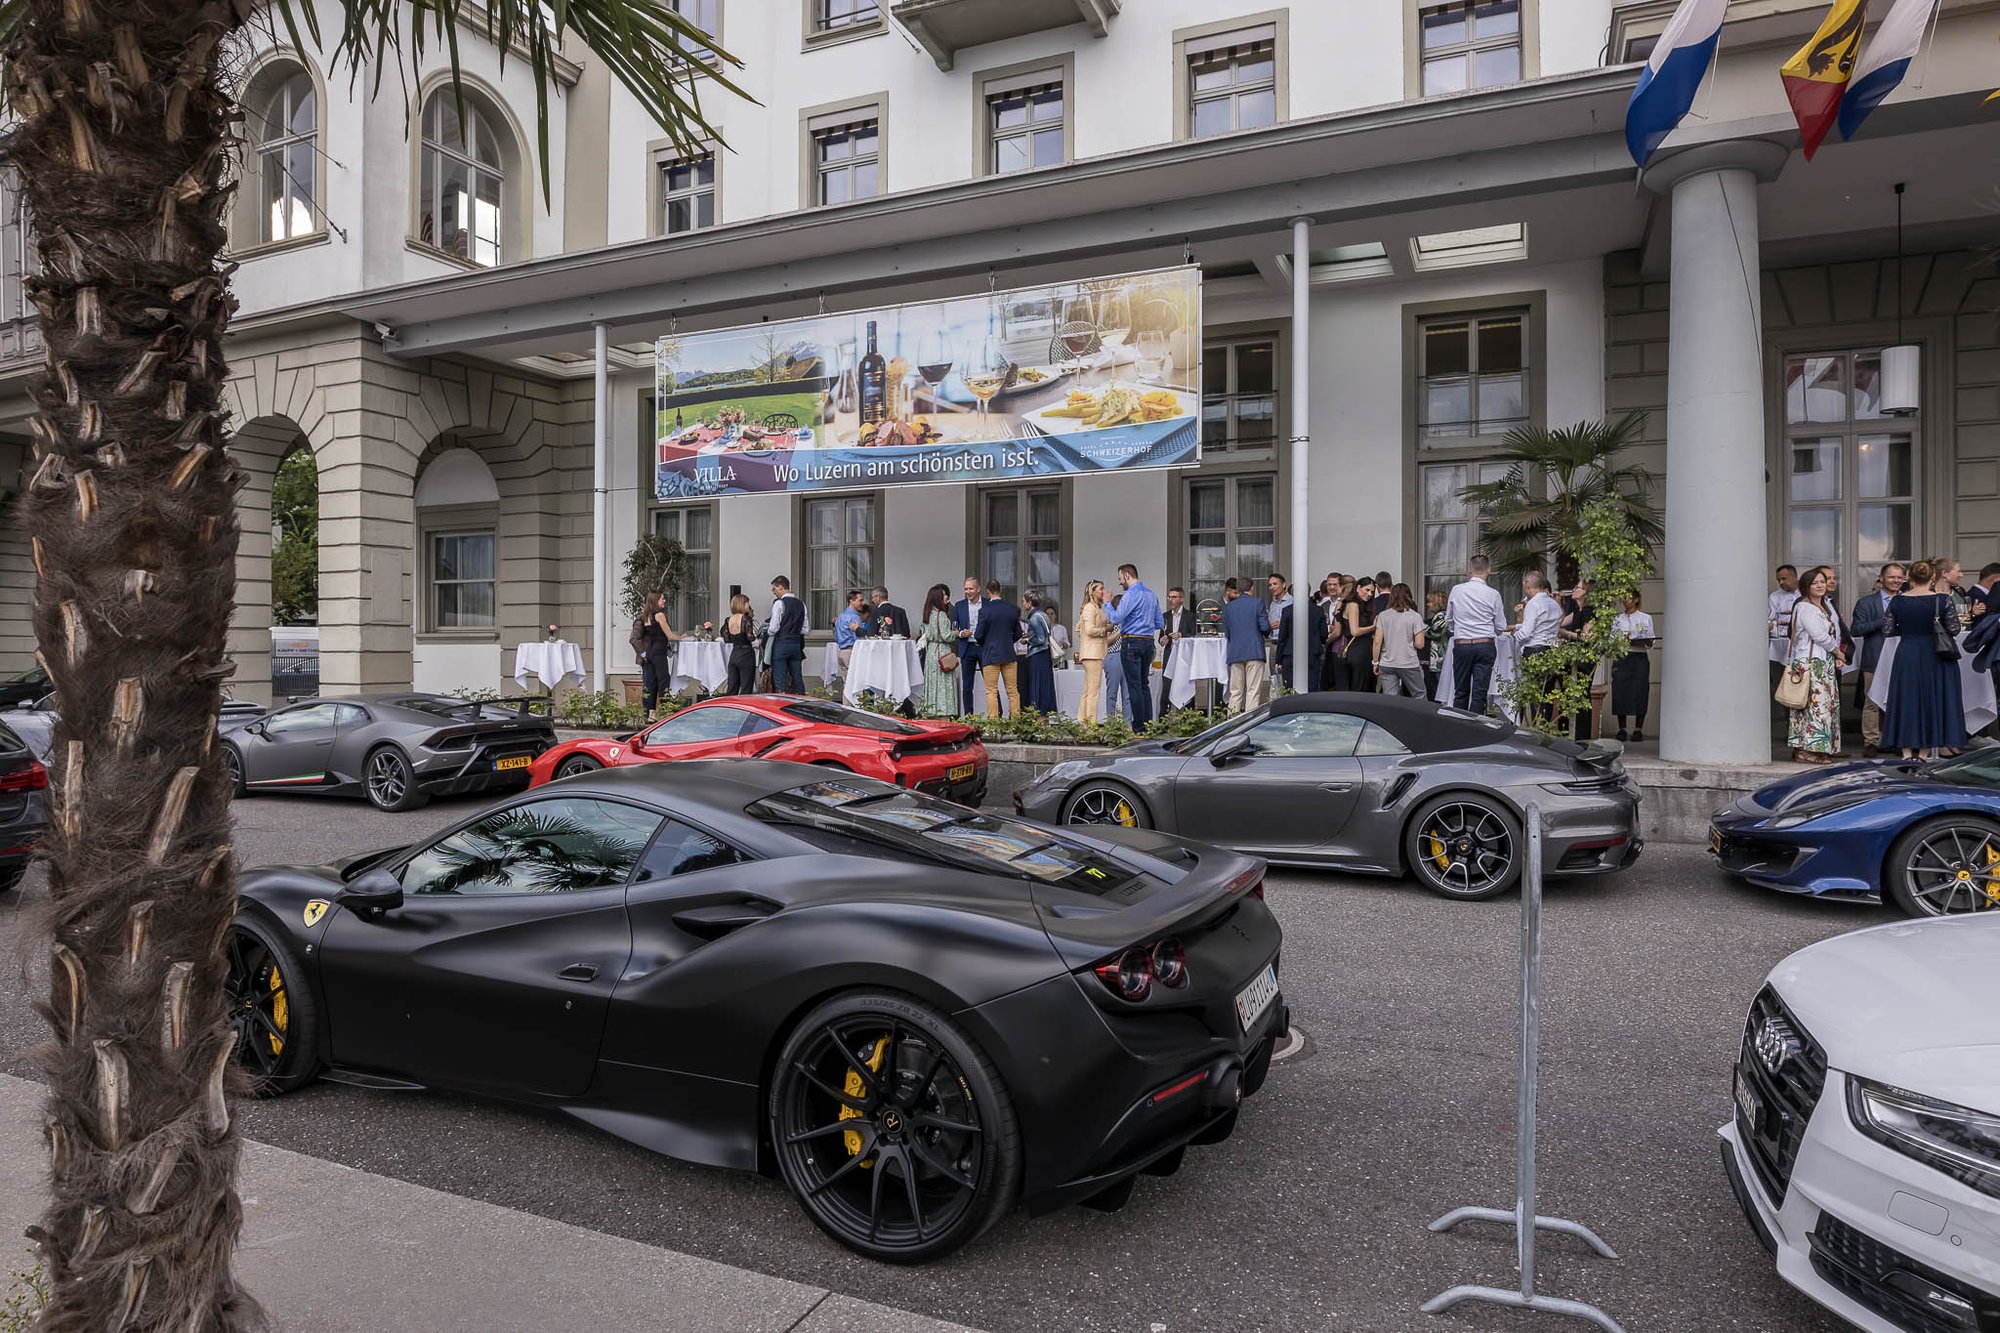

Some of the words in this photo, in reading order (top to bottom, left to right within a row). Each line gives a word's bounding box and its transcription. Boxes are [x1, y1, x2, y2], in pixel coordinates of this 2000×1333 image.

[1080, 445, 1153, 458] SCHWEIZERHOF
[693, 465, 738, 483] VILLA
[773, 464, 798, 482] Wo
[805, 462, 861, 481] Luzern
[867, 460, 895, 477] am
[901, 452, 994, 475] schönsten
[1001, 448, 1039, 468] isst.
